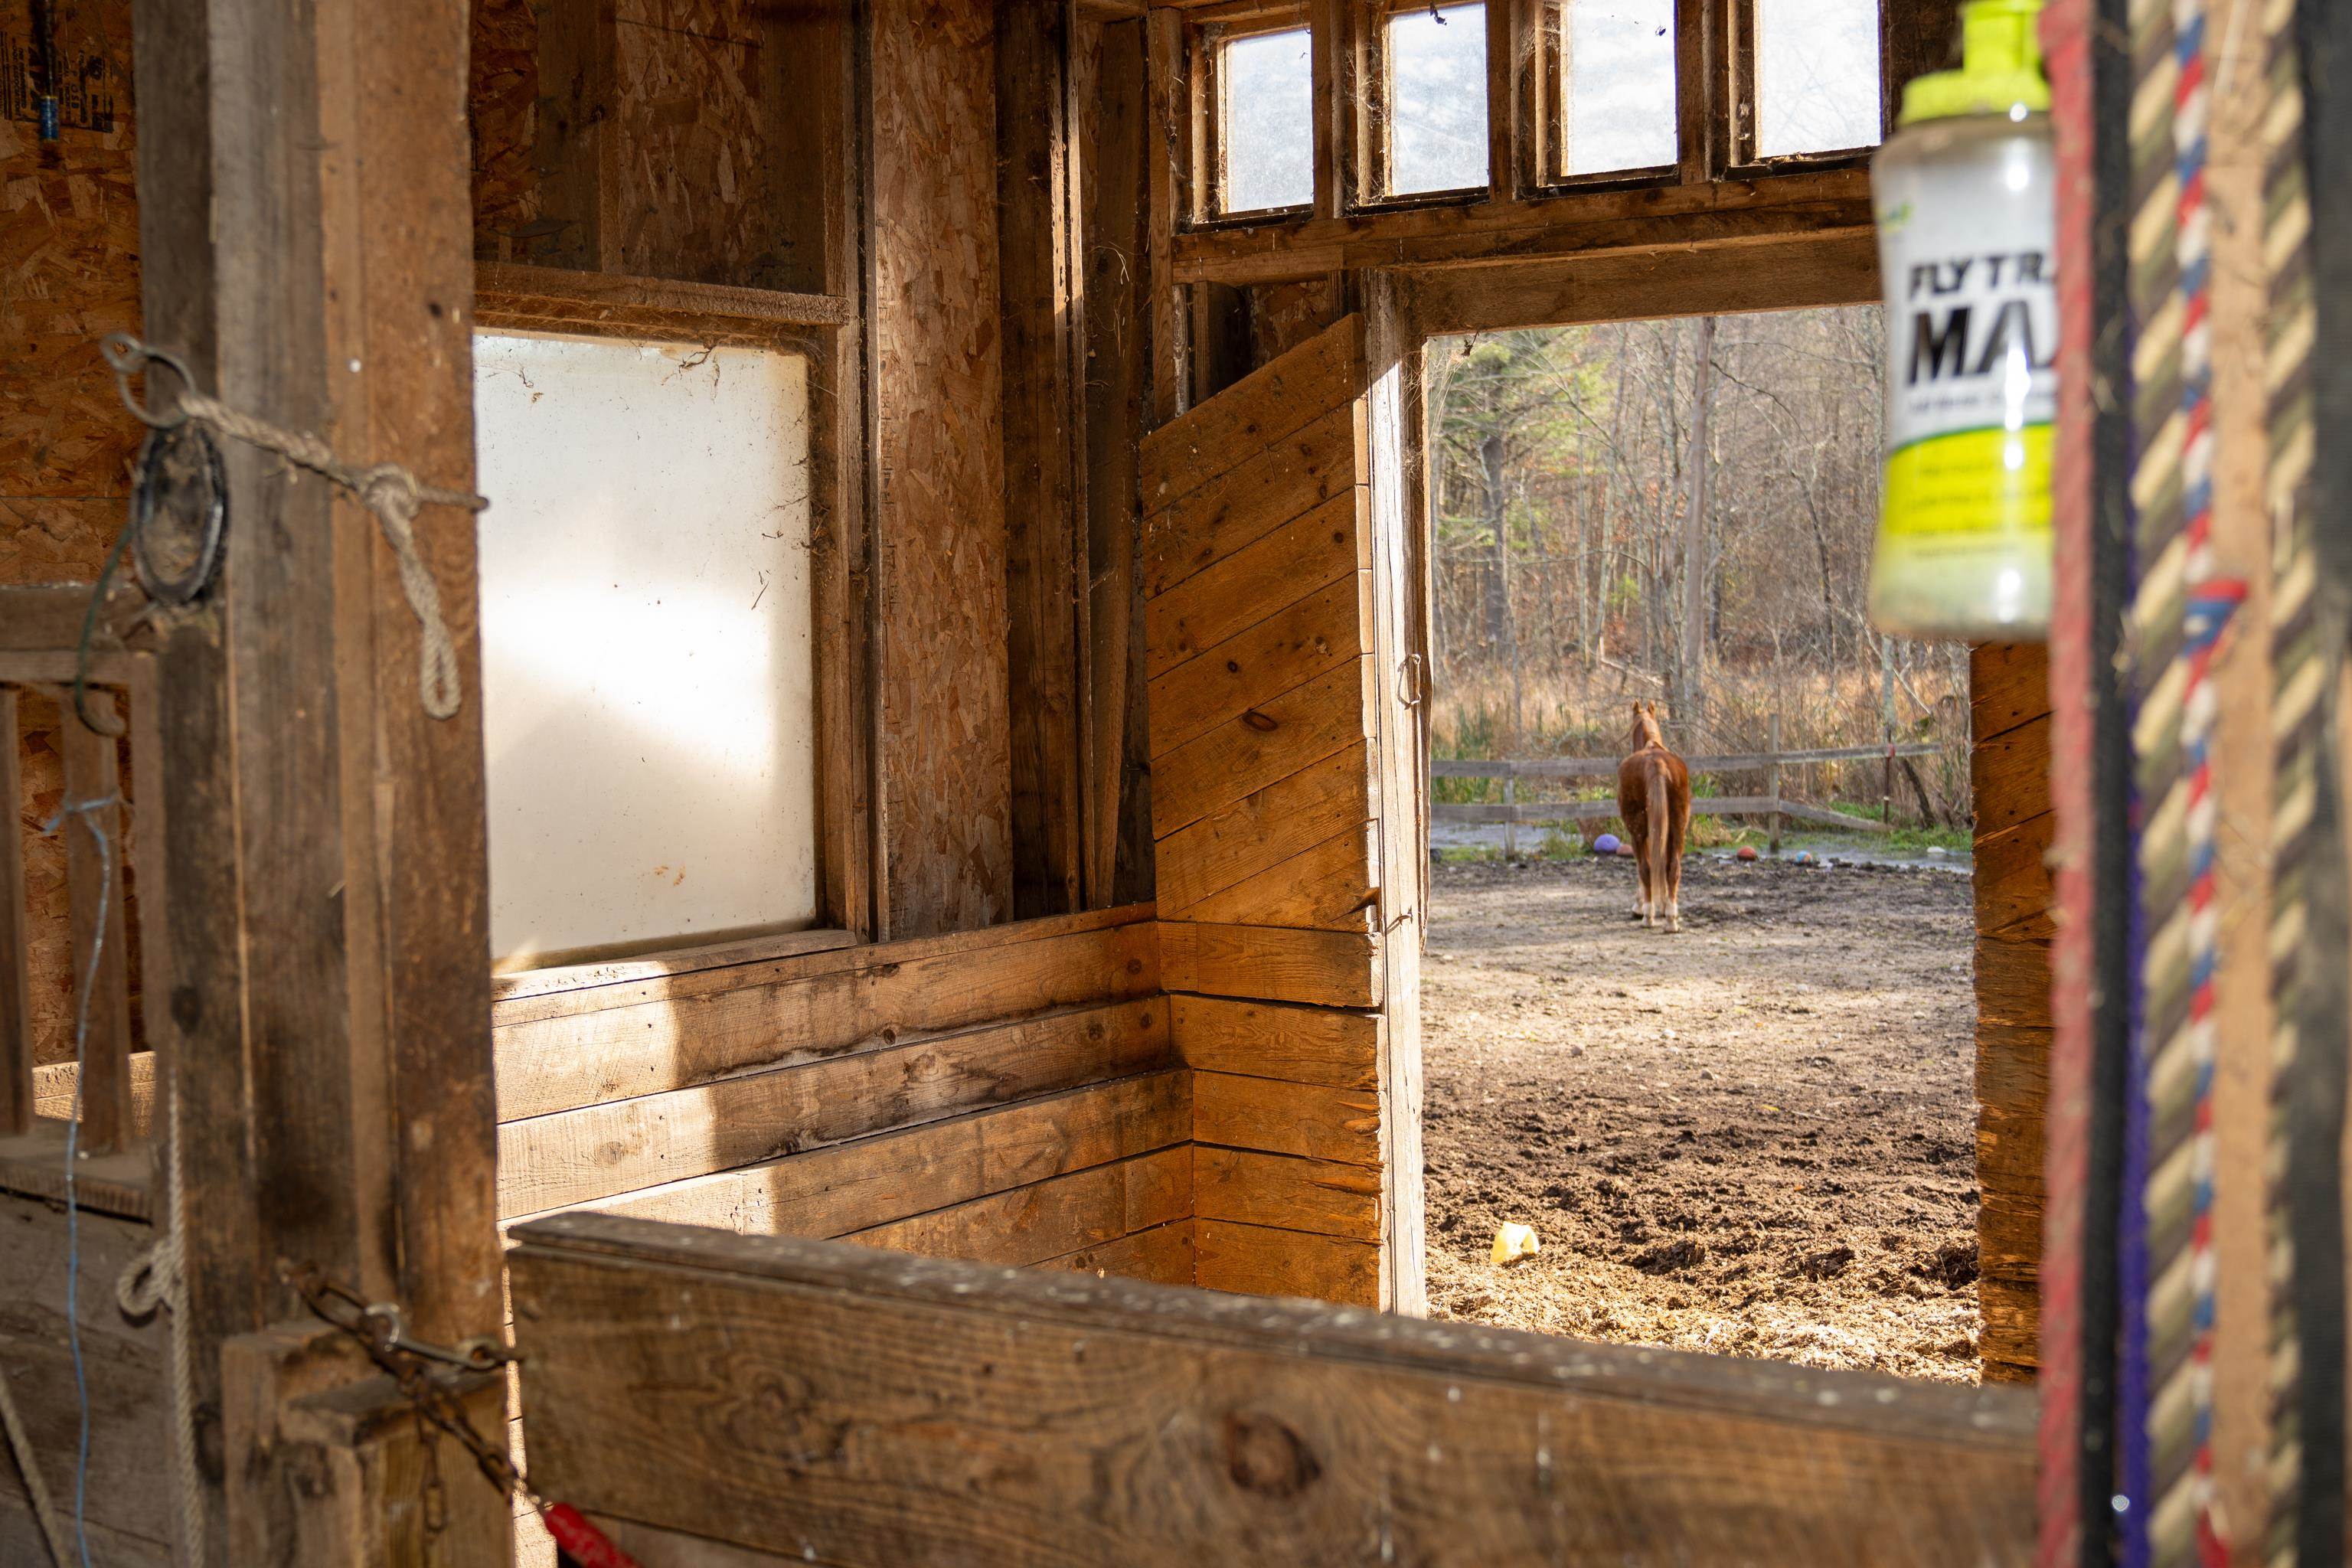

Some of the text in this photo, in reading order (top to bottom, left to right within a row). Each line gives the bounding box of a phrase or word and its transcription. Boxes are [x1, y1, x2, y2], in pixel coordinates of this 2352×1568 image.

[1907, 251, 2057, 299] FLY TR
[1906, 301, 2057, 385] MA
